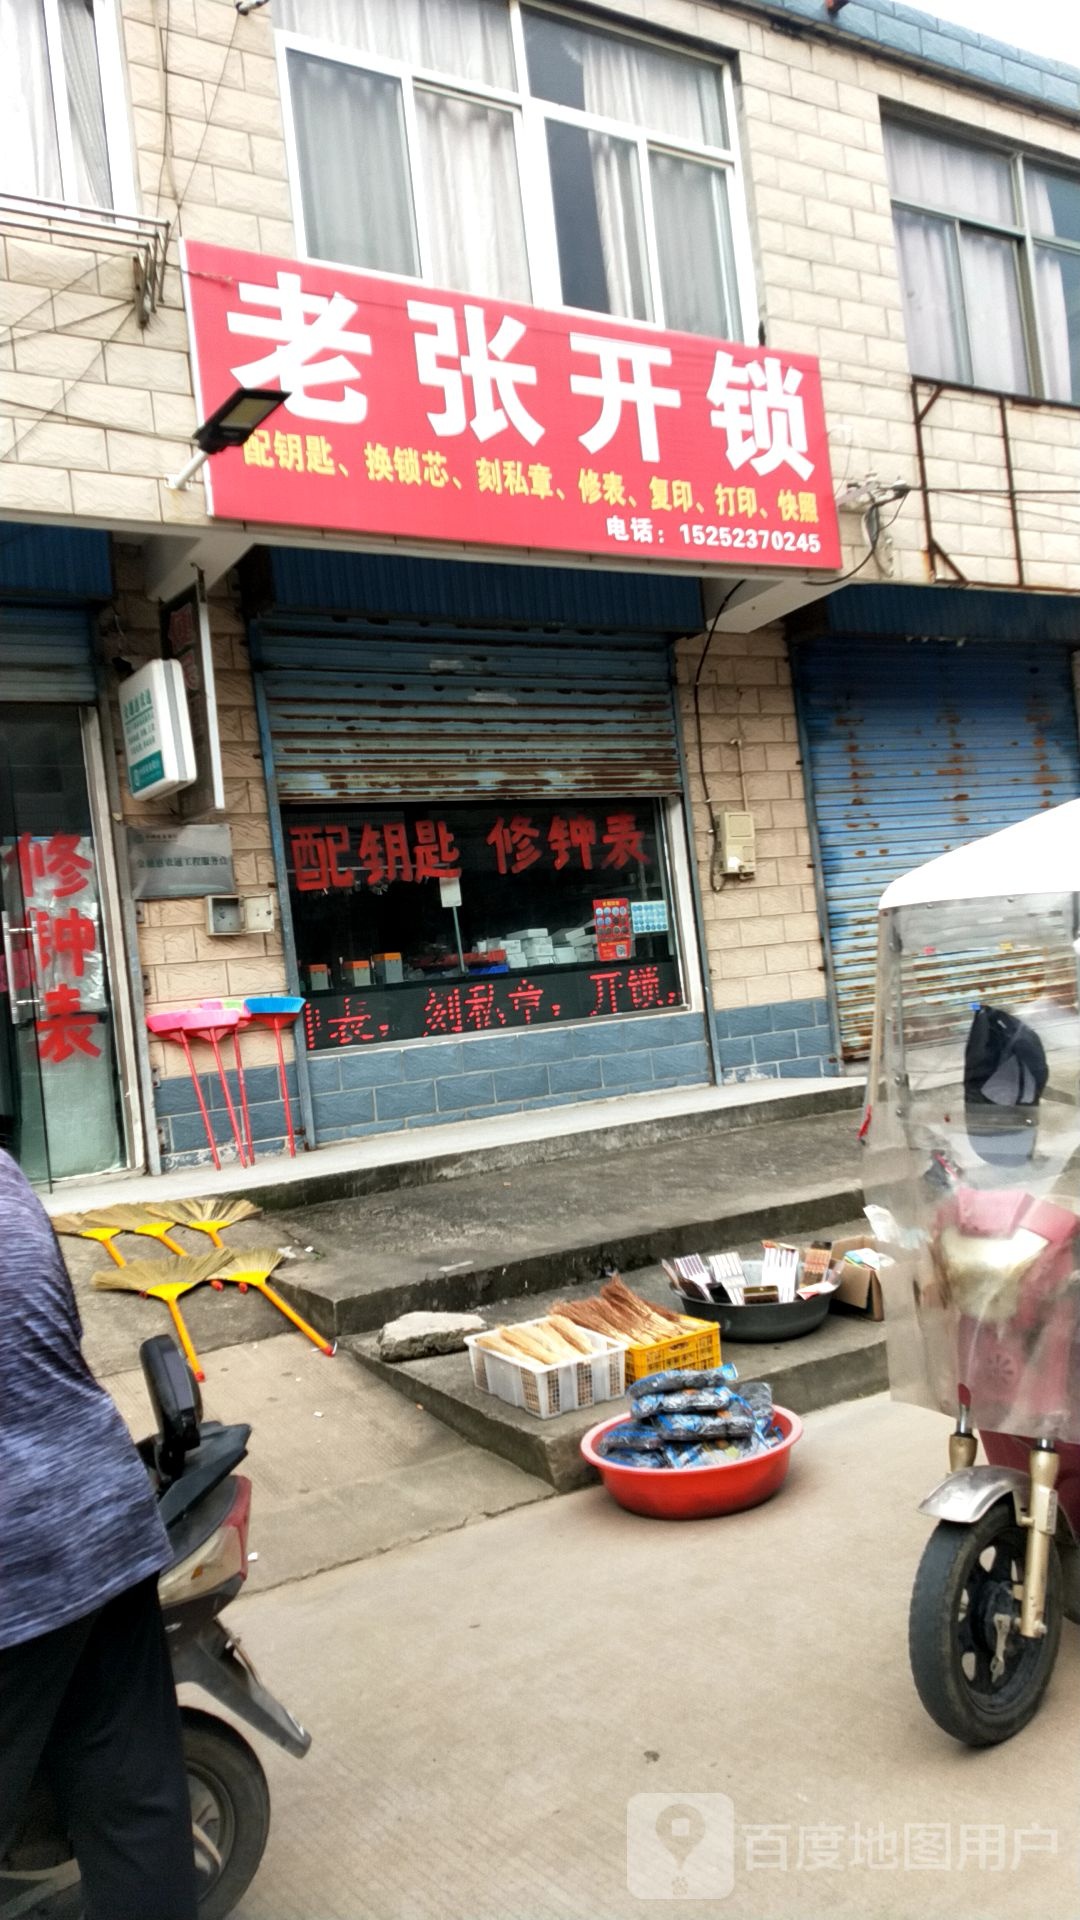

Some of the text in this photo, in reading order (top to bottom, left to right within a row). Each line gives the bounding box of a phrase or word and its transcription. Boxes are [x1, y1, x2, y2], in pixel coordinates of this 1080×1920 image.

[227, 272, 815, 480] 老张开锁
[243, 429, 819, 523] 配钥匙、换锁芯、刻私章、修表、复印、打印、快照
[289, 813, 652, 891] 配钥匙 修钟表
[4, 832, 102, 1063] 修钟表
